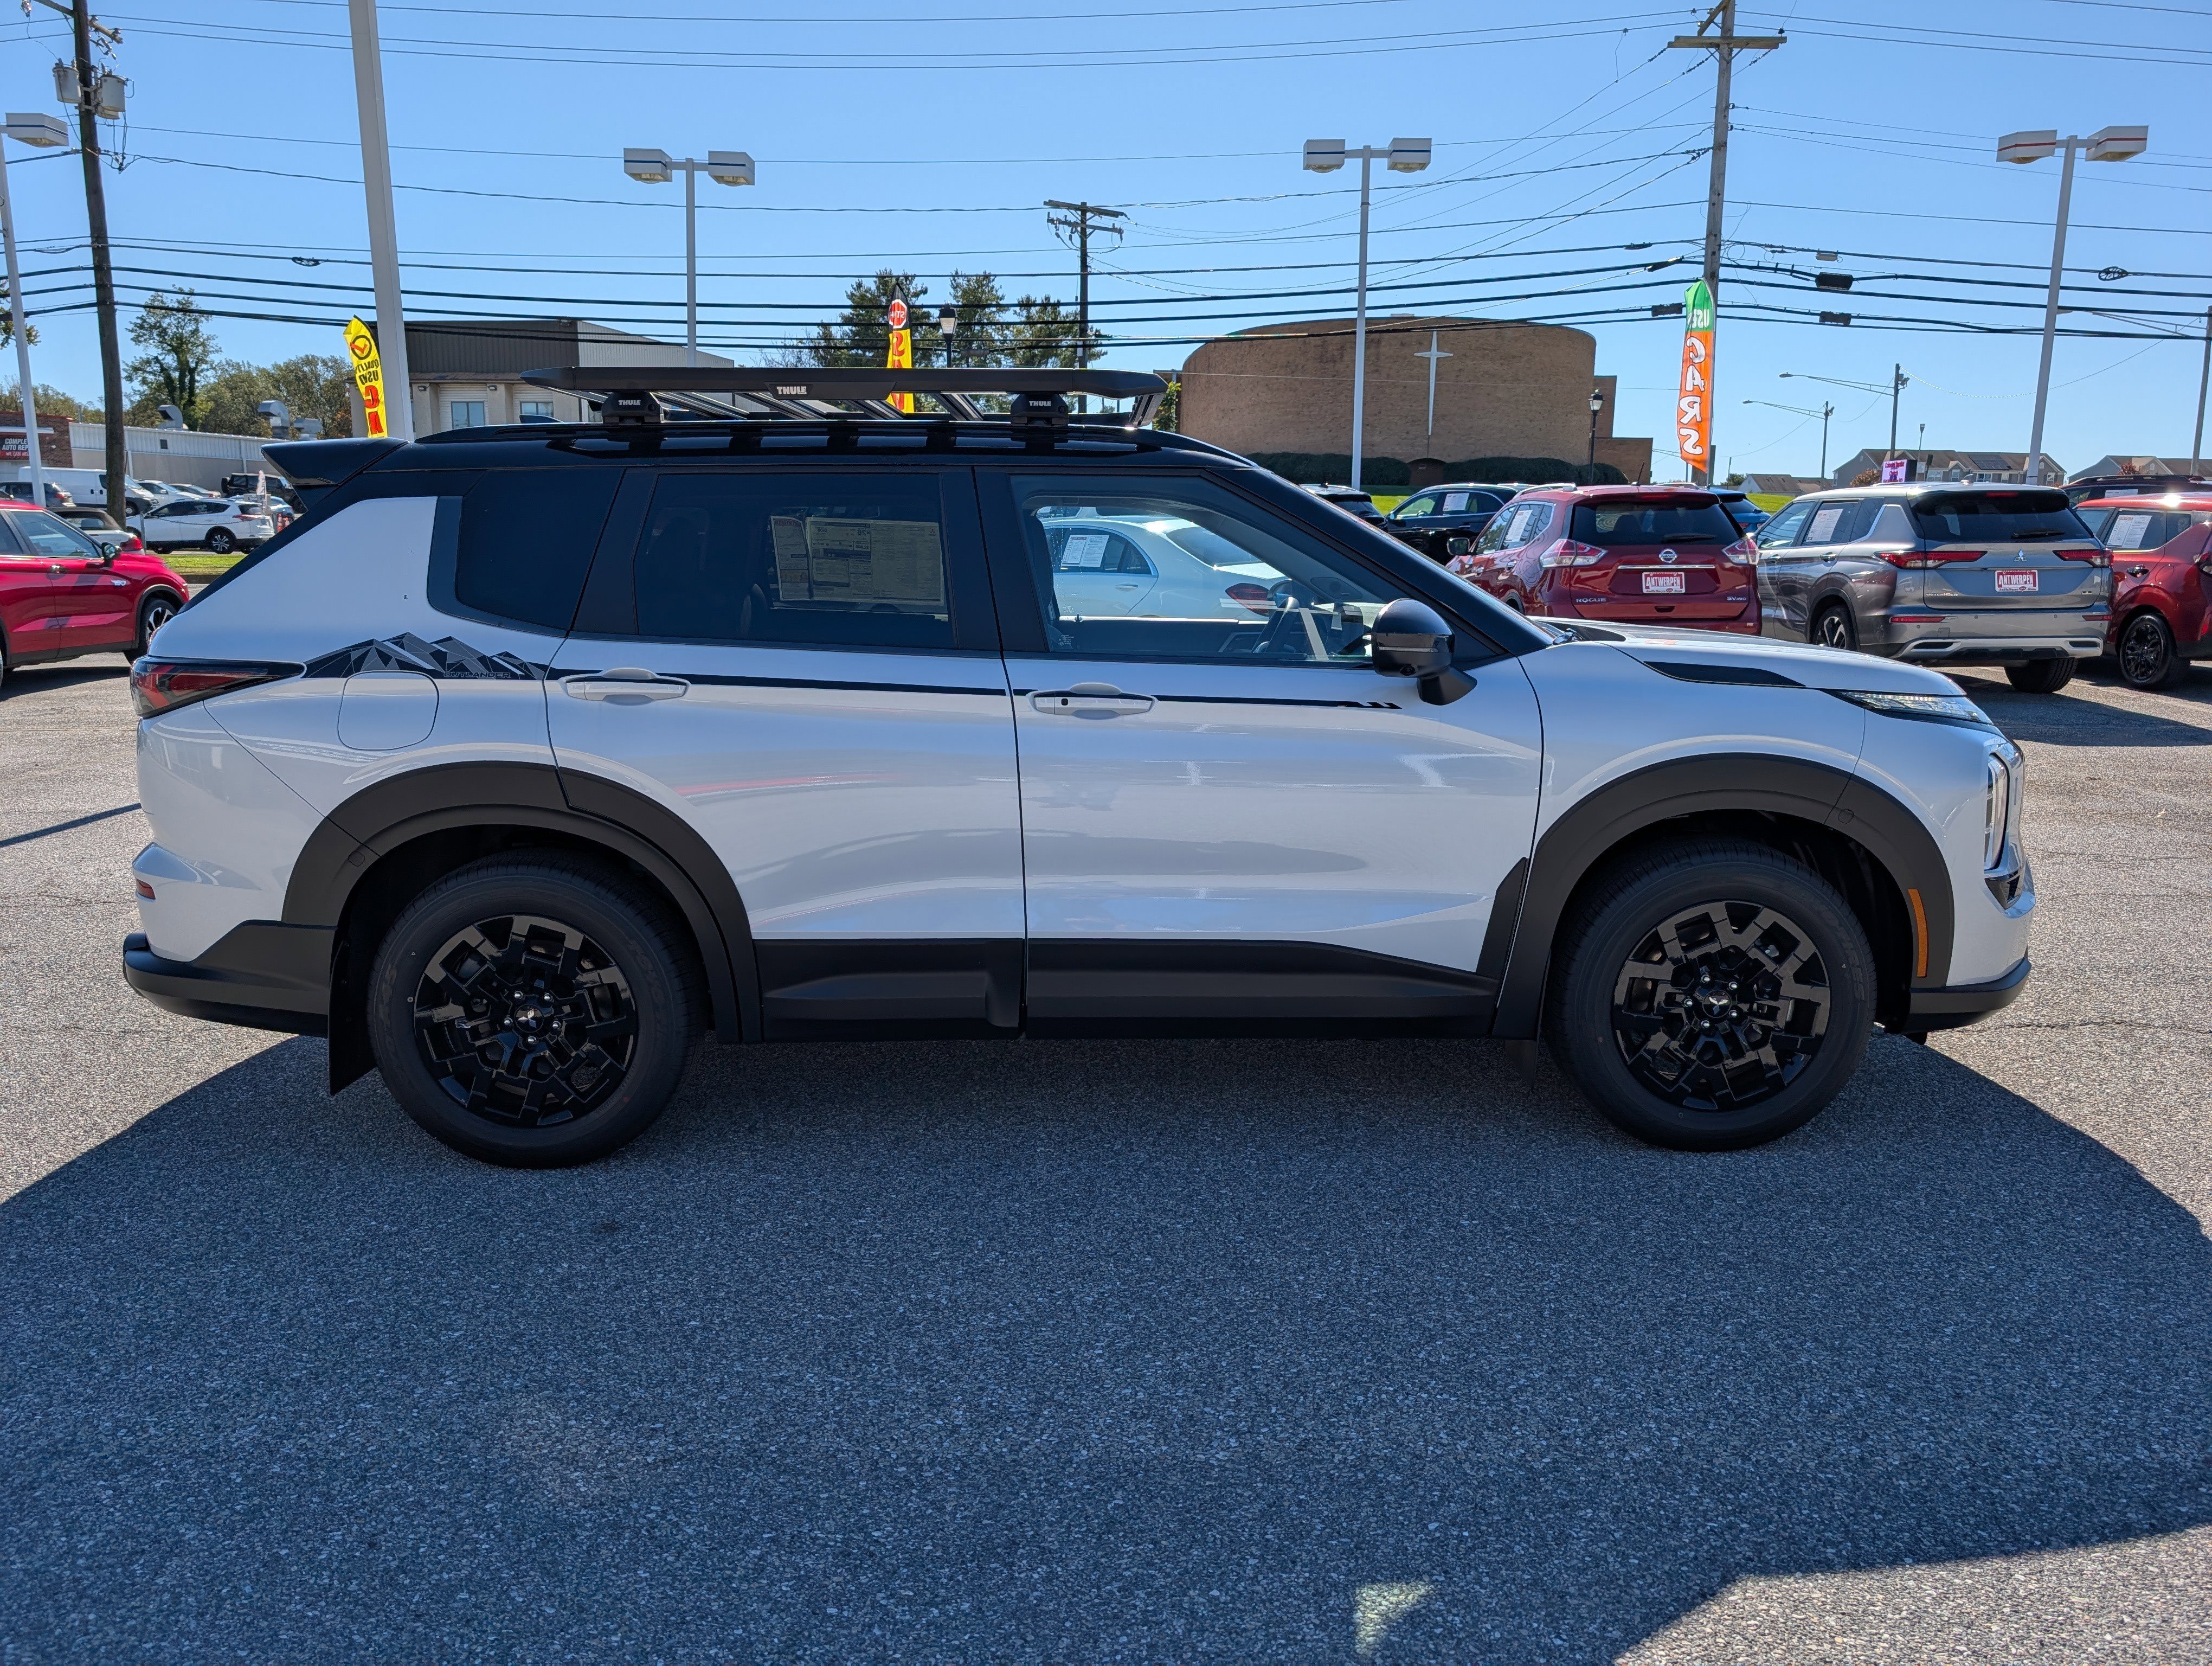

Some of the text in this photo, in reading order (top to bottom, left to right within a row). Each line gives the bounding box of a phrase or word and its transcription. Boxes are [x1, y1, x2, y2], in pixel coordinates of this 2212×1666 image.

[776, 386, 807, 395] THULE
[1646, 576, 1680, 587] ANTWERPEN
[1999, 574, 2033, 585] ANTWERPEN
